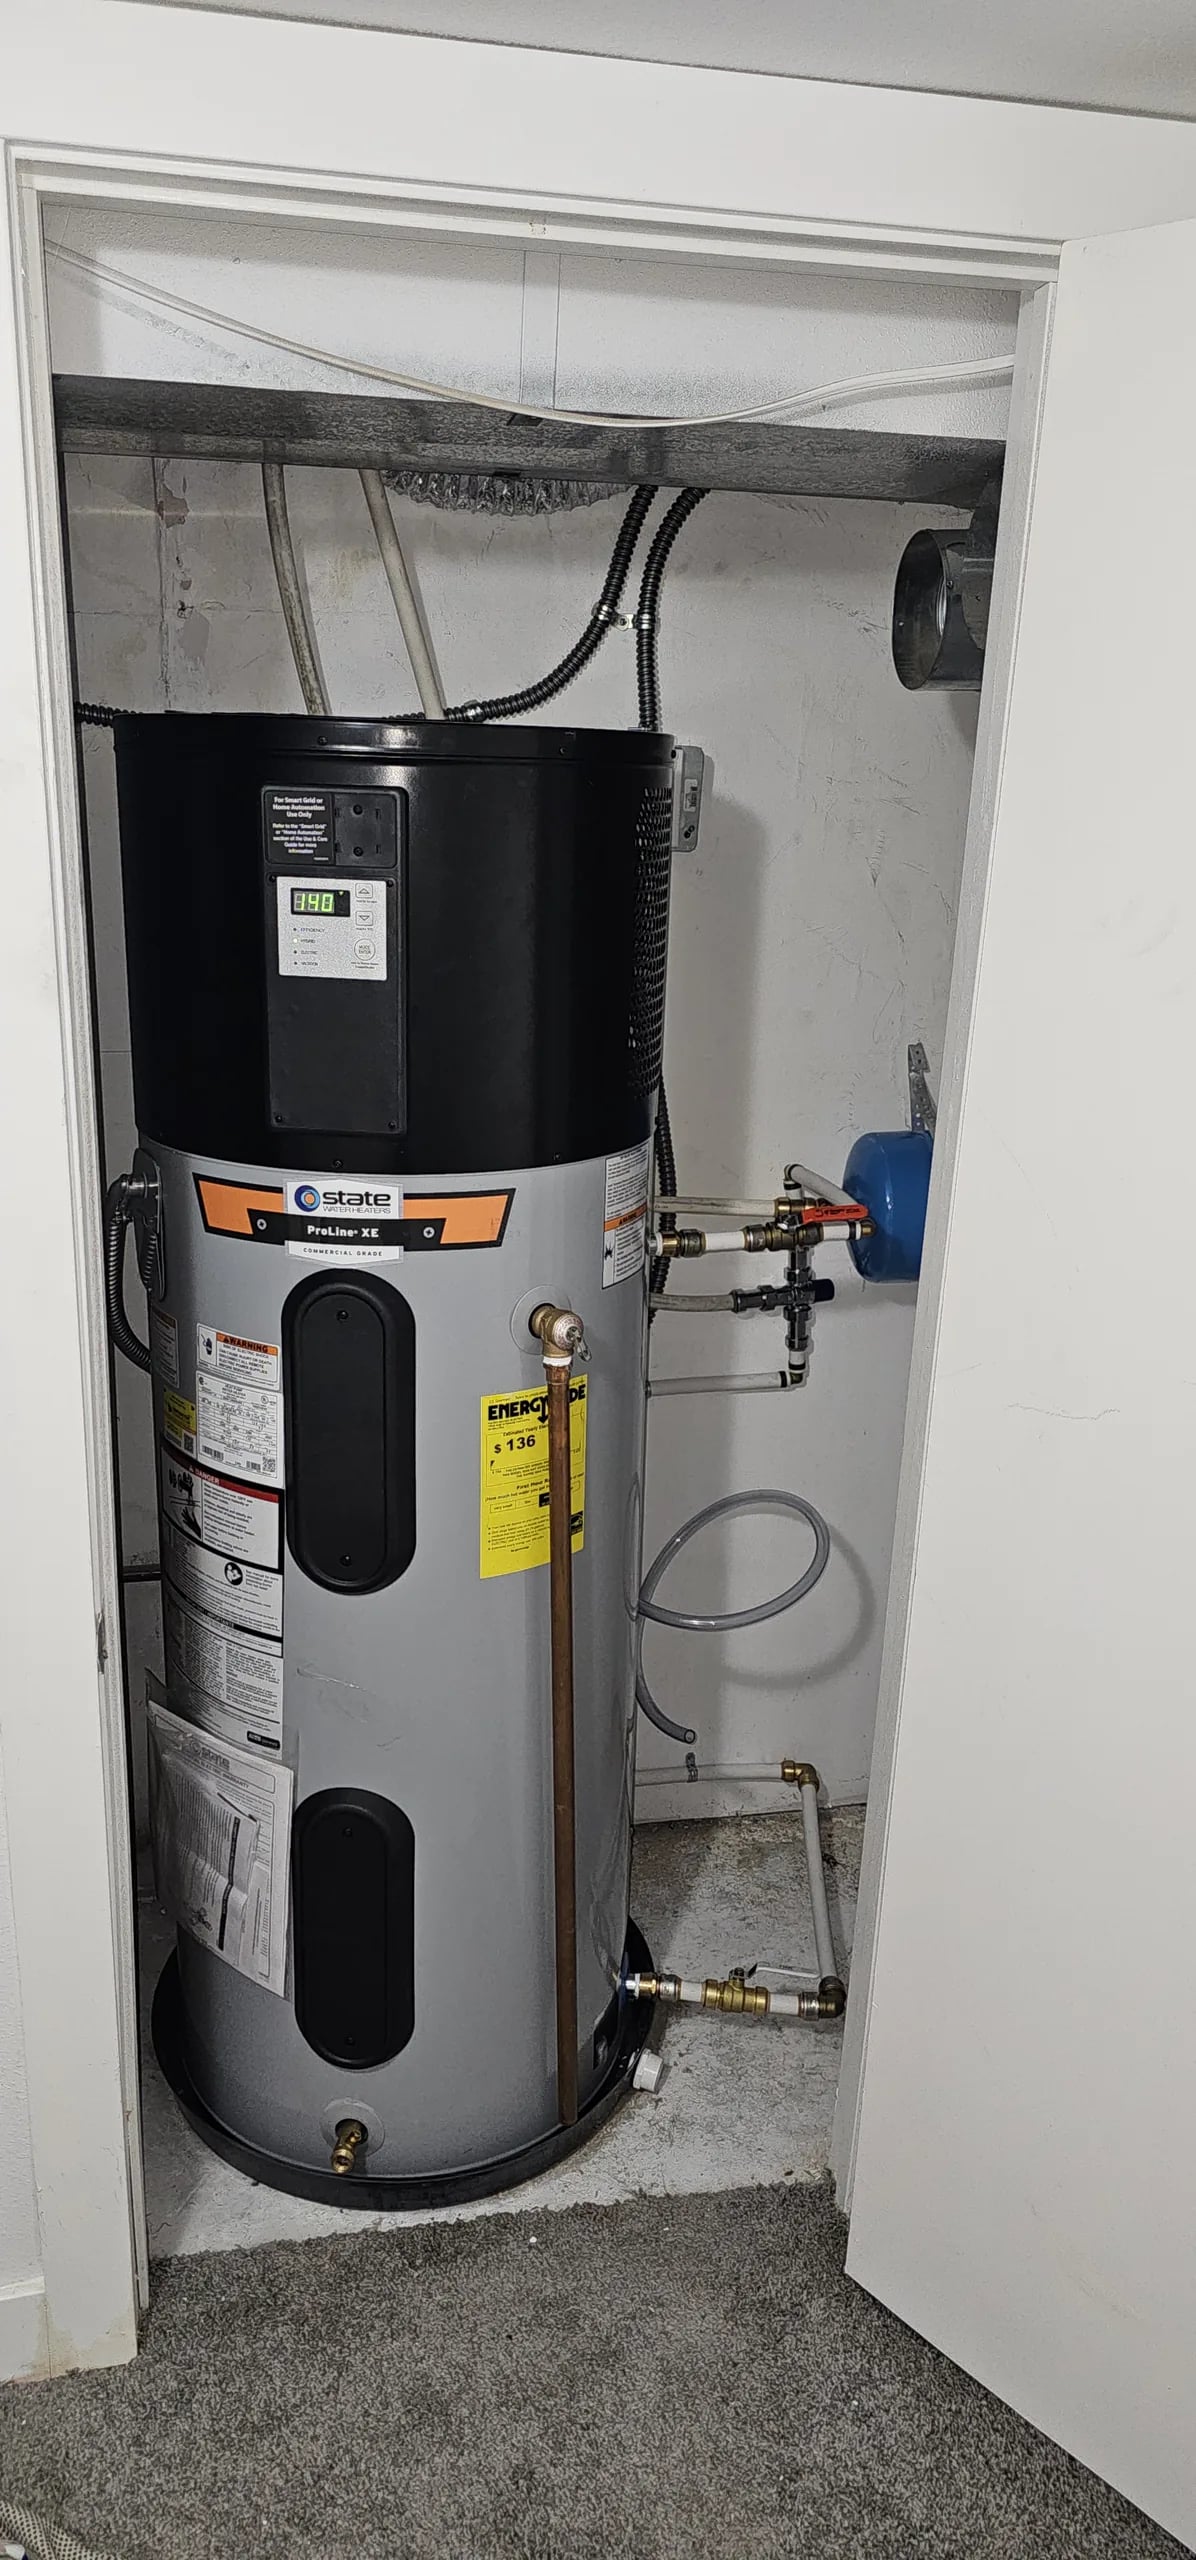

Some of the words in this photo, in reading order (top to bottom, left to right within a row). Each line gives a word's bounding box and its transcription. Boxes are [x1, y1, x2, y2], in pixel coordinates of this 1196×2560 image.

[298, 811, 312, 819] Only
[300, 893, 334, 912] 140
[322, 1190, 391, 1206] state
[361, 1228, 379, 1237] XE
[303, 1248, 352, 1256] COMMERCIAL
[228, 1336, 268, 1353] WARNING
[506, 1434, 536, 1451] 136
[195, 1468, 220, 1484] DANGER
[201, 1746, 230, 1772] state
